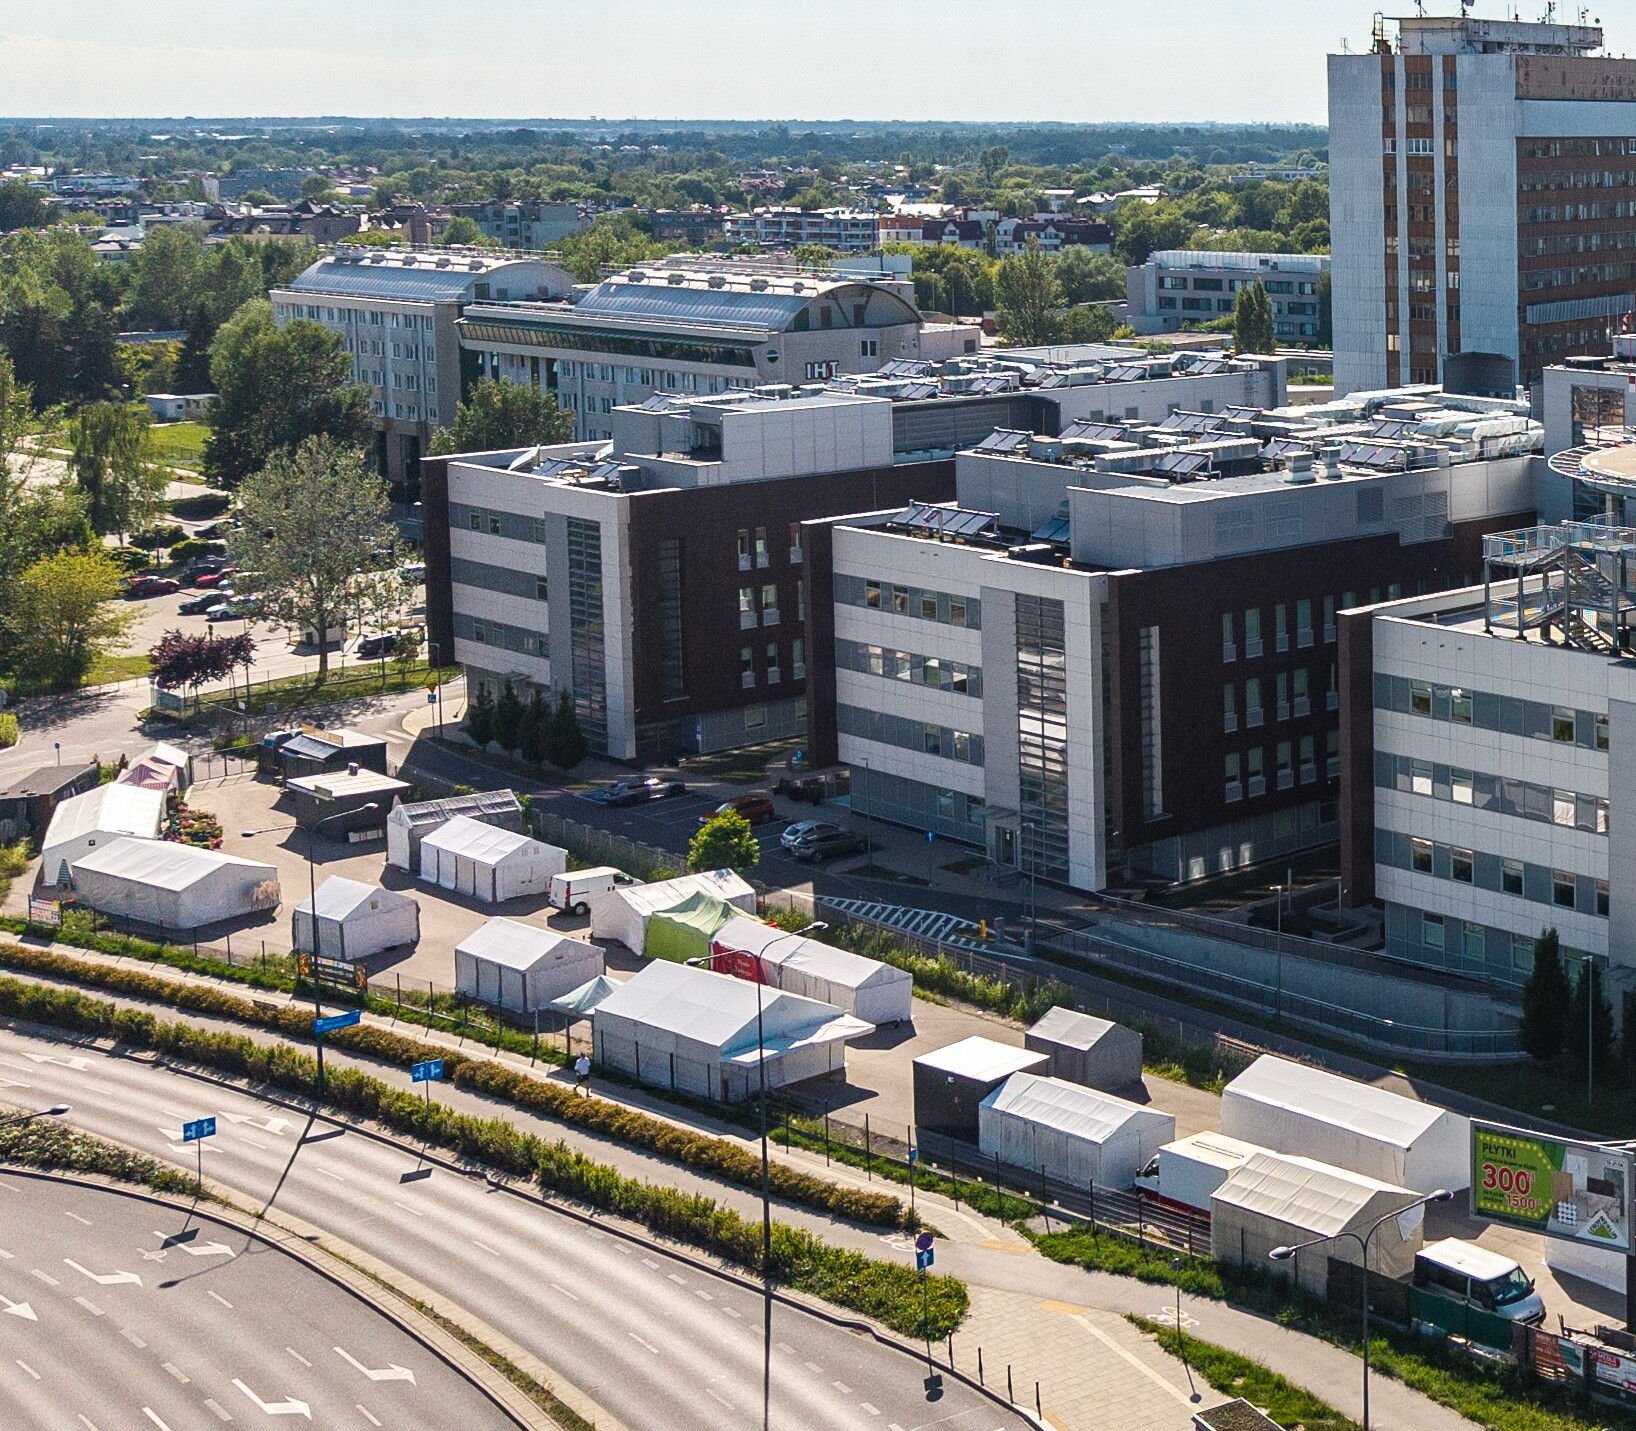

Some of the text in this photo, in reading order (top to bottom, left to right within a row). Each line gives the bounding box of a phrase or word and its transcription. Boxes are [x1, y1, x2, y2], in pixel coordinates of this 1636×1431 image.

[805, 360, 839, 380] IHT
[1482, 1163, 1530, 1195] 300
[1507, 1194, 1536, 1210] 1500
